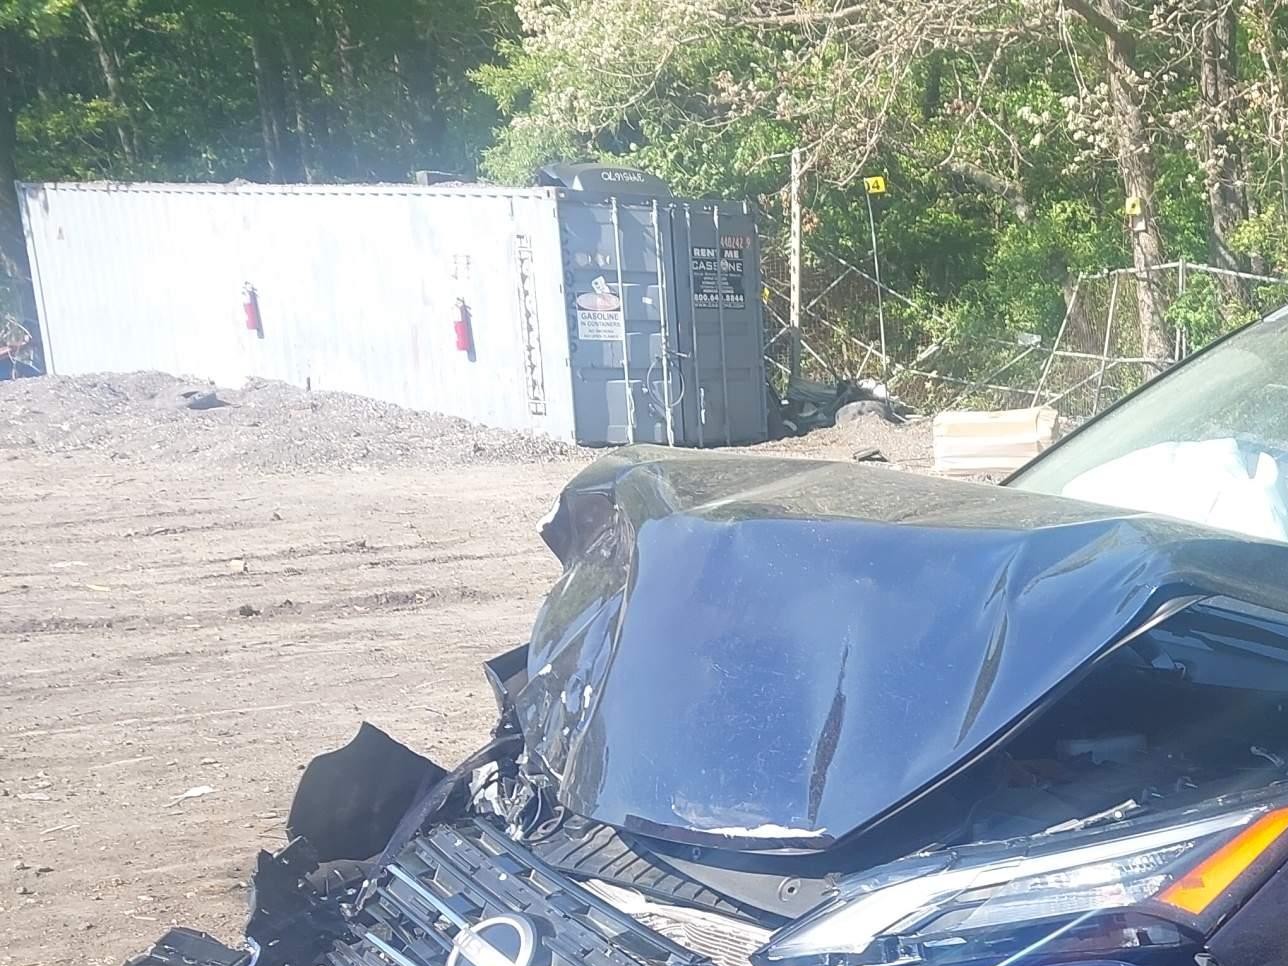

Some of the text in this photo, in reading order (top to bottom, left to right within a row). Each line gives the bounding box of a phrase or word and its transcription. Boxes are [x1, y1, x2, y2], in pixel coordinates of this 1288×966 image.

[724, 249, 739, 259] ME
[694, 293, 744, 303] 800.64.8844
[581, 311, 619, 321] GASOLINE
